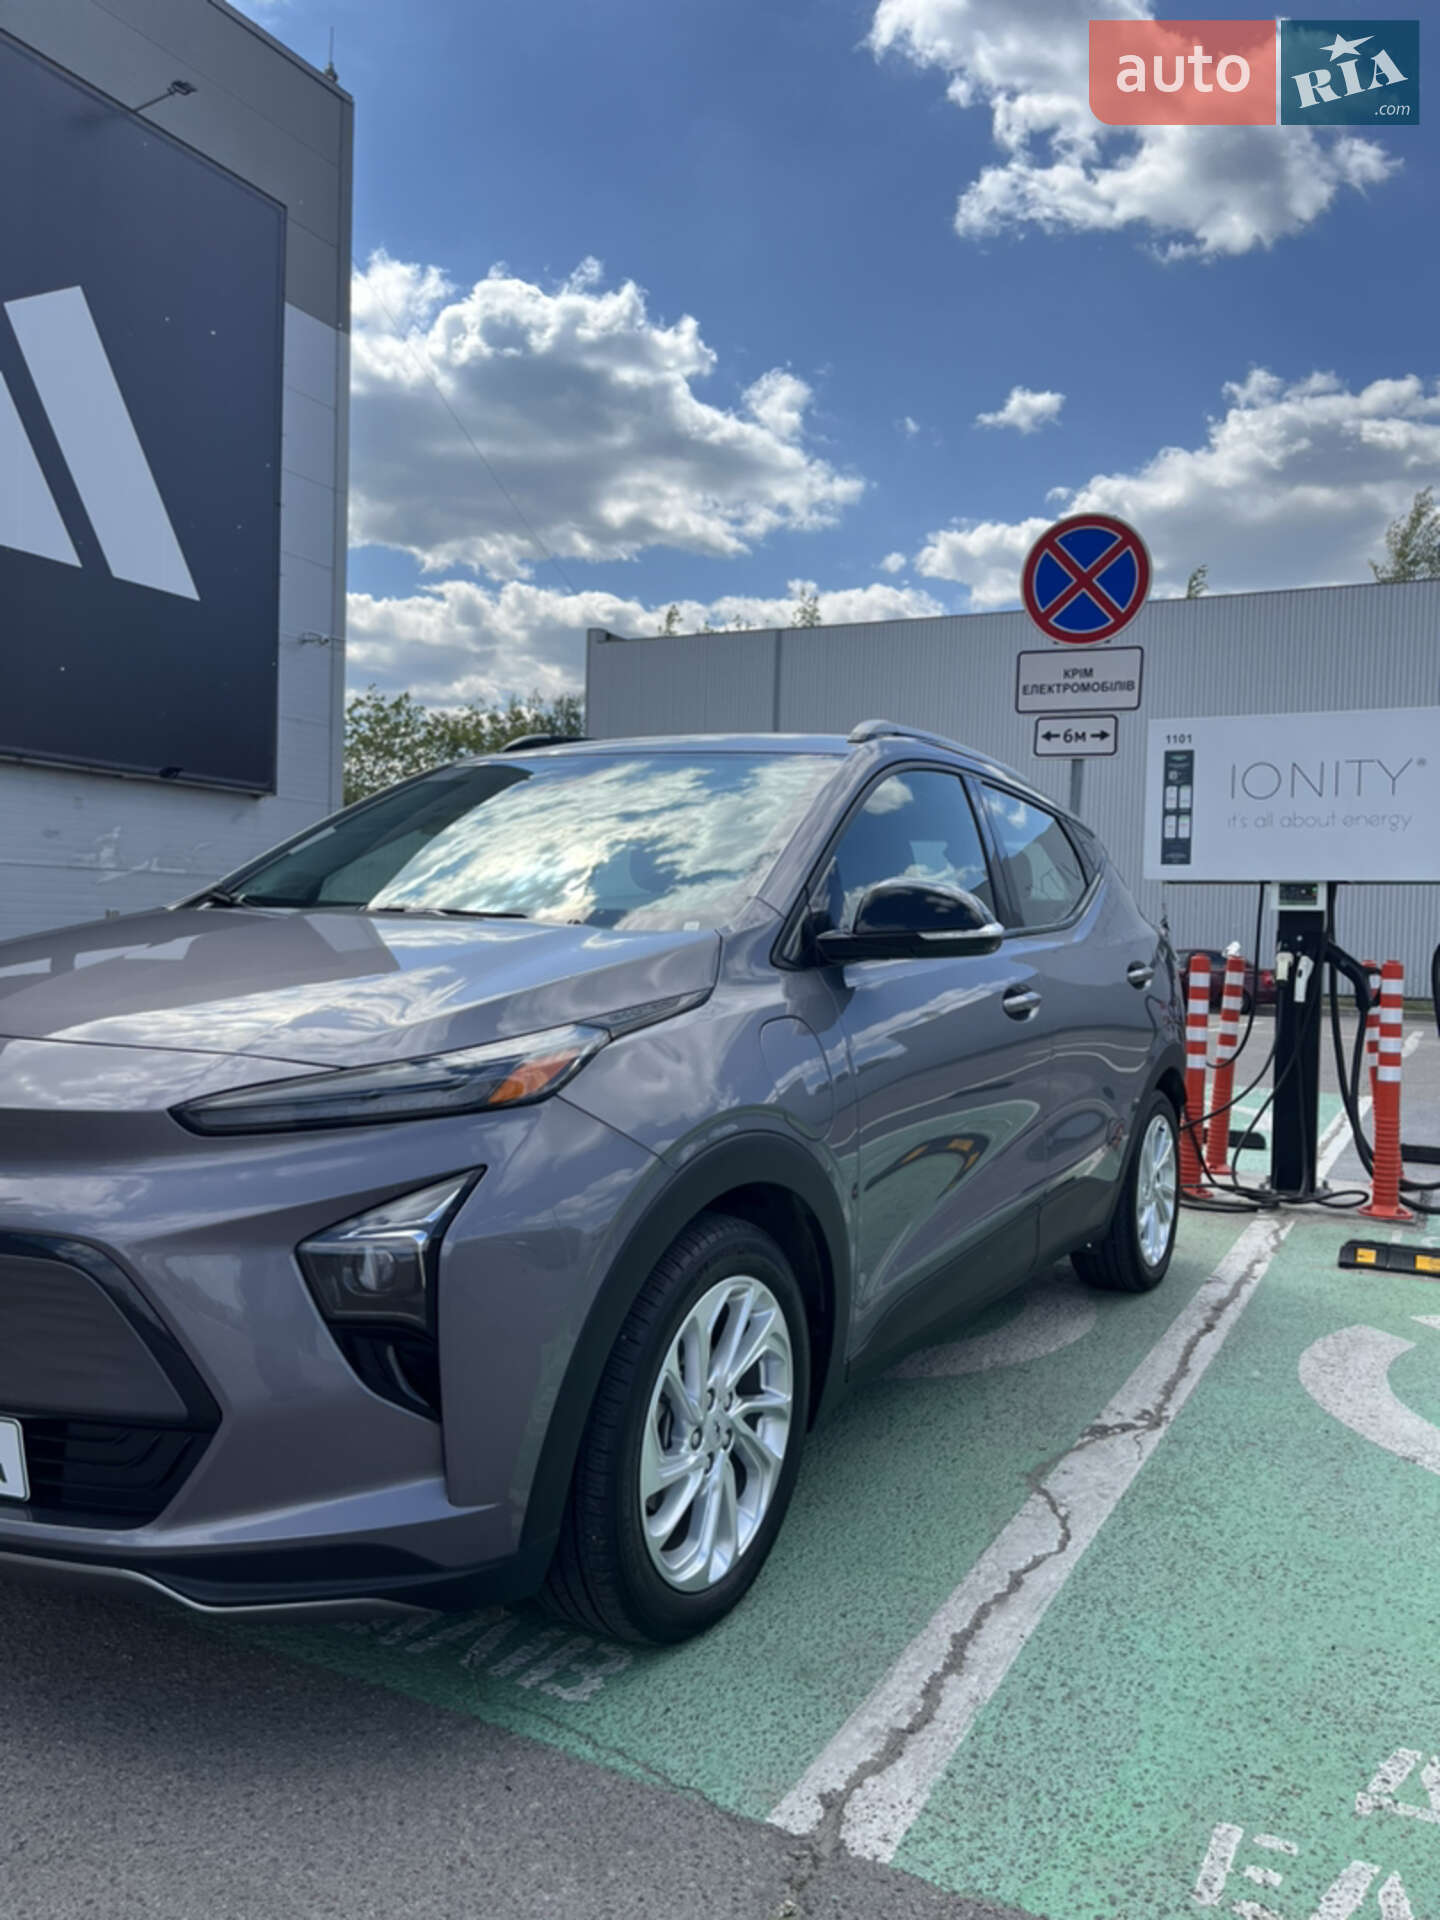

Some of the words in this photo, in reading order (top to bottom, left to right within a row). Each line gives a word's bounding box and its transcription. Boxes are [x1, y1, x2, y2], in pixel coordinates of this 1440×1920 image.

[1062, 667, 1094, 680] КРІМ
[1021, 680, 1136, 696] ЕЛЕКТРОМОБІЛІВ
[1165, 732, 1193, 745] 1101
[1253, 811, 1274, 829] all
[1279, 809, 1337, 829] about
[1341, 812, 1413, 833] energy
